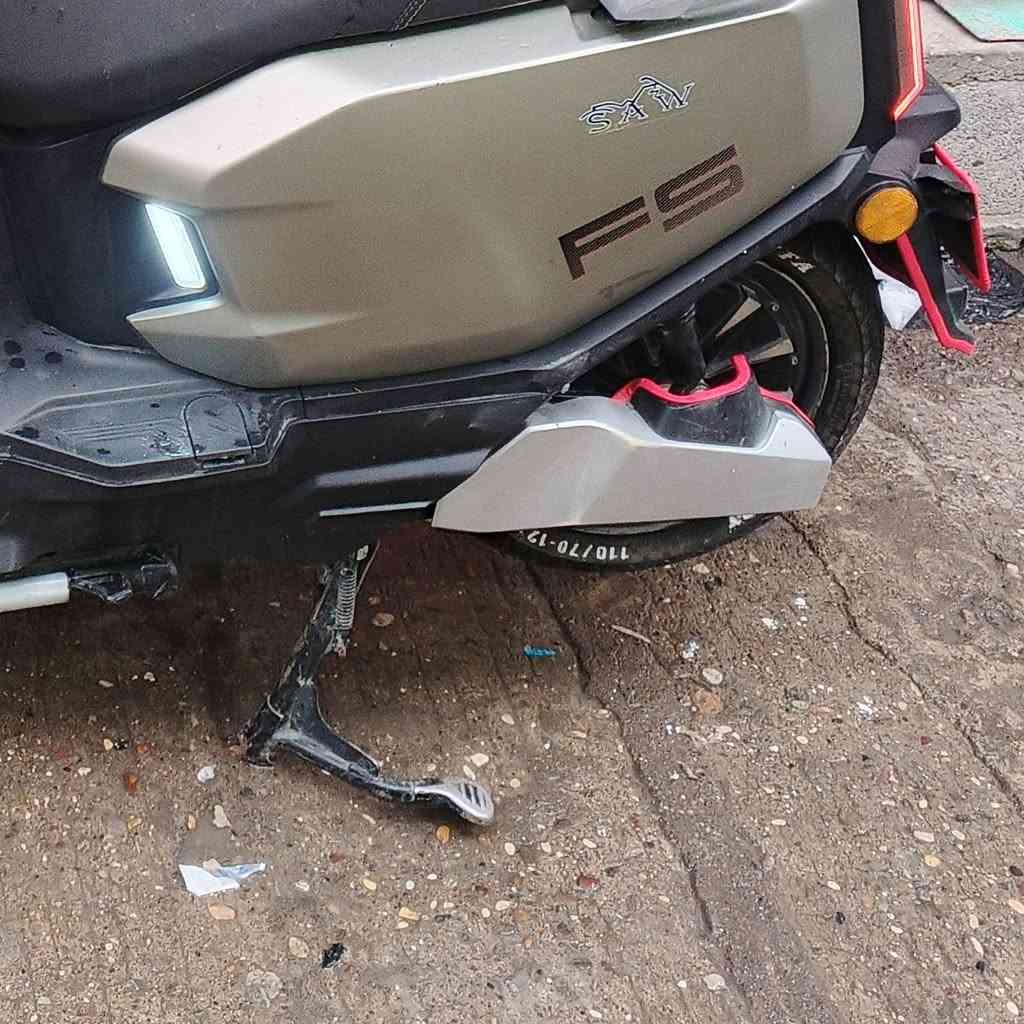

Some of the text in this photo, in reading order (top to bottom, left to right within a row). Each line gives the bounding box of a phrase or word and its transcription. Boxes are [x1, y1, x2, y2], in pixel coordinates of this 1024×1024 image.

[579, 75, 695, 134] SAW
[558, 143, 745, 280] FS
[527, 530, 630, 560] 110/70-12
